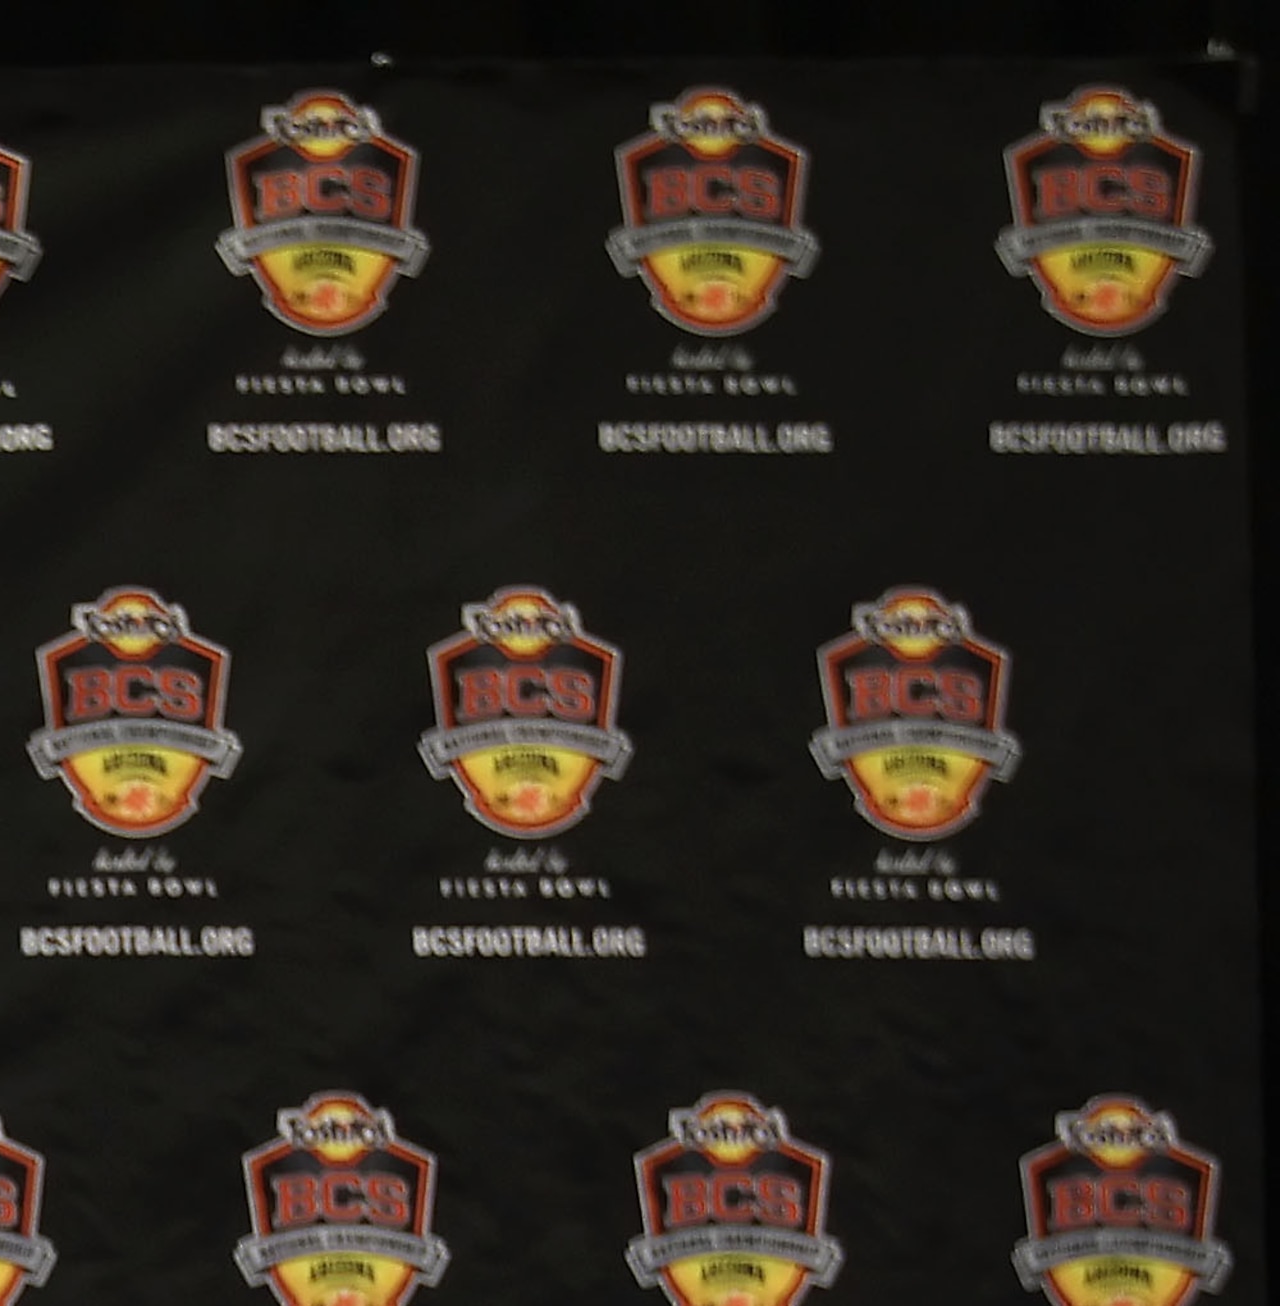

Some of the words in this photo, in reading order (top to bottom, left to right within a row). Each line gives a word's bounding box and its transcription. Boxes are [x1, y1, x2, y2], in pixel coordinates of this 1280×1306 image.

[258, 162, 392, 219] BCS
[207, 422, 442, 453] BCSFOOTBALL.ORG
[69, 663, 204, 720] BCS
[460, 663, 596, 720] BCS
[850, 665, 983, 722] BCS
[19, 925, 256, 957] BCSFOOTBALL.ORG
[411, 925, 647, 958] BCSFOOTBALL.ORG
[803, 925, 1035, 960] BCSFOOTBALL.ORG
[275, 1171, 411, 1228] BCS
[667, 1170, 804, 1227] BCS
